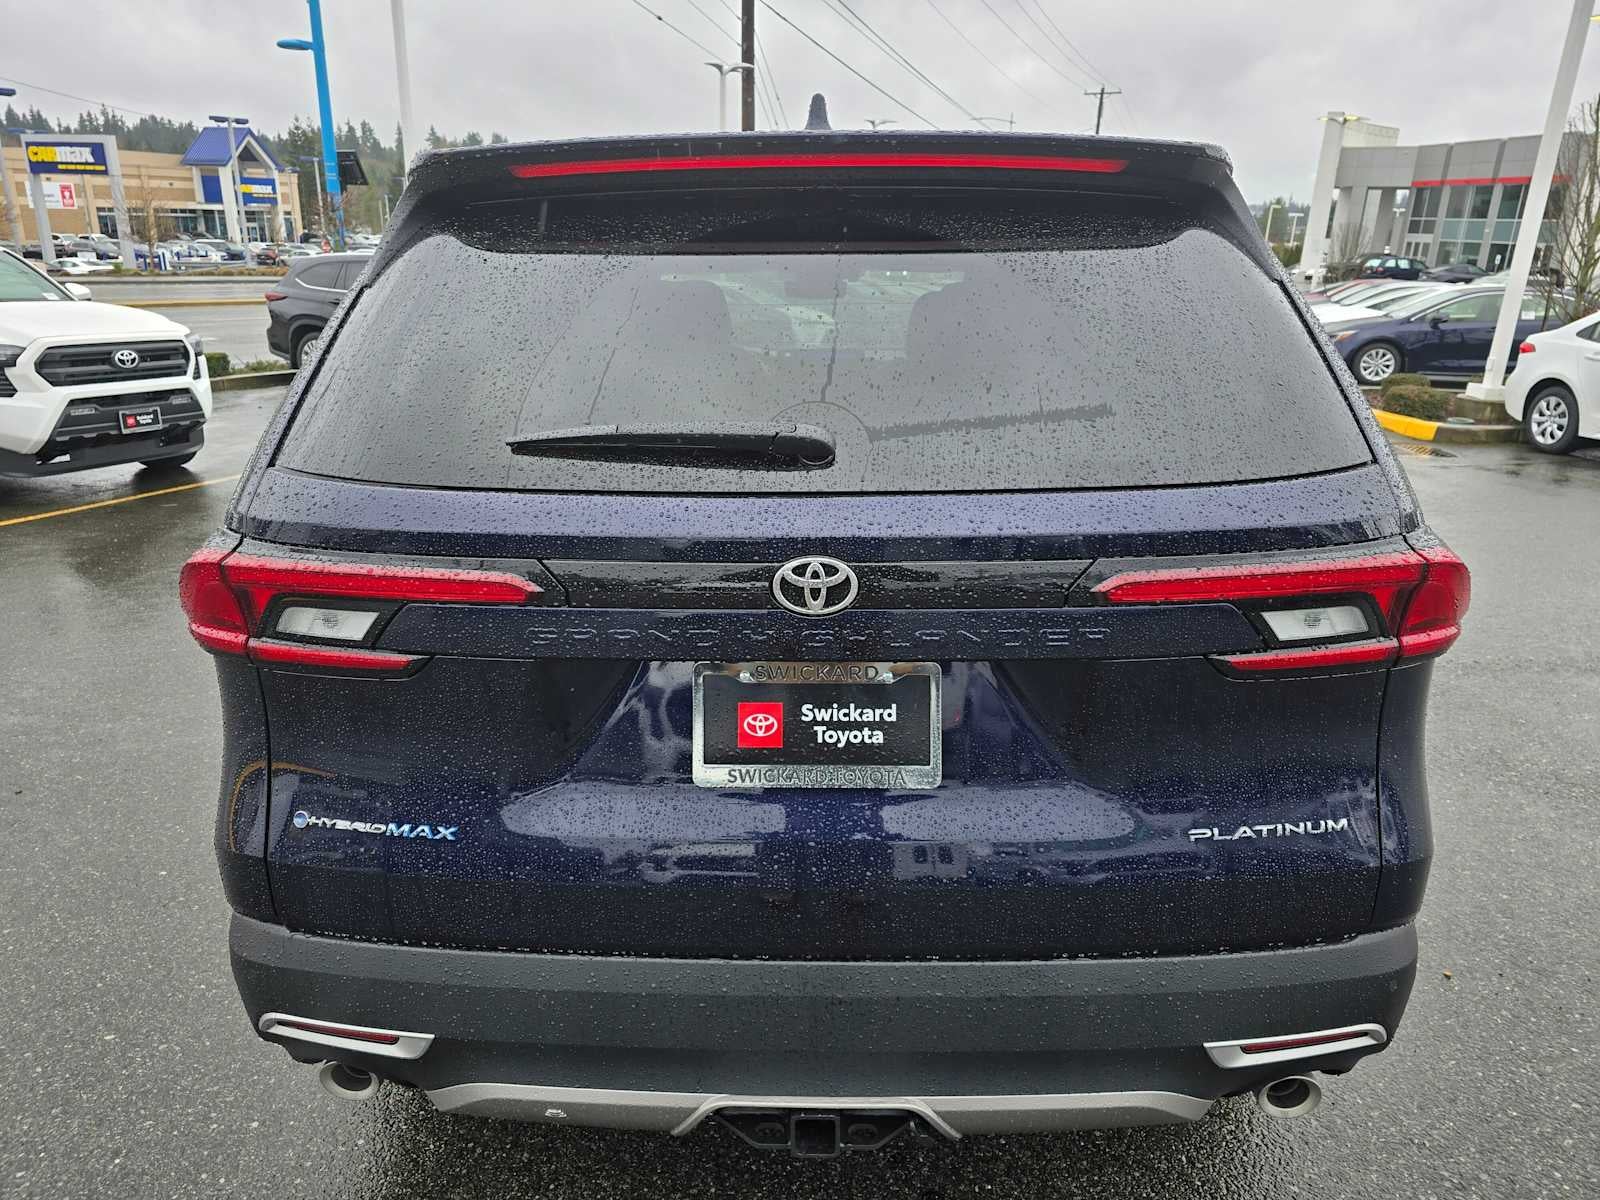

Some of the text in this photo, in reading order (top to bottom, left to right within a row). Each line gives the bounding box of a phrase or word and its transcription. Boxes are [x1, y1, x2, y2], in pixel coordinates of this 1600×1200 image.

[755, 664, 879, 682] SWICKARD
[801, 703, 897, 722] Swickard
[813, 725, 883, 748] Toyota
[727, 768, 827, 785] SWICKARD
[1187, 818, 1349, 842] PLATINUM
